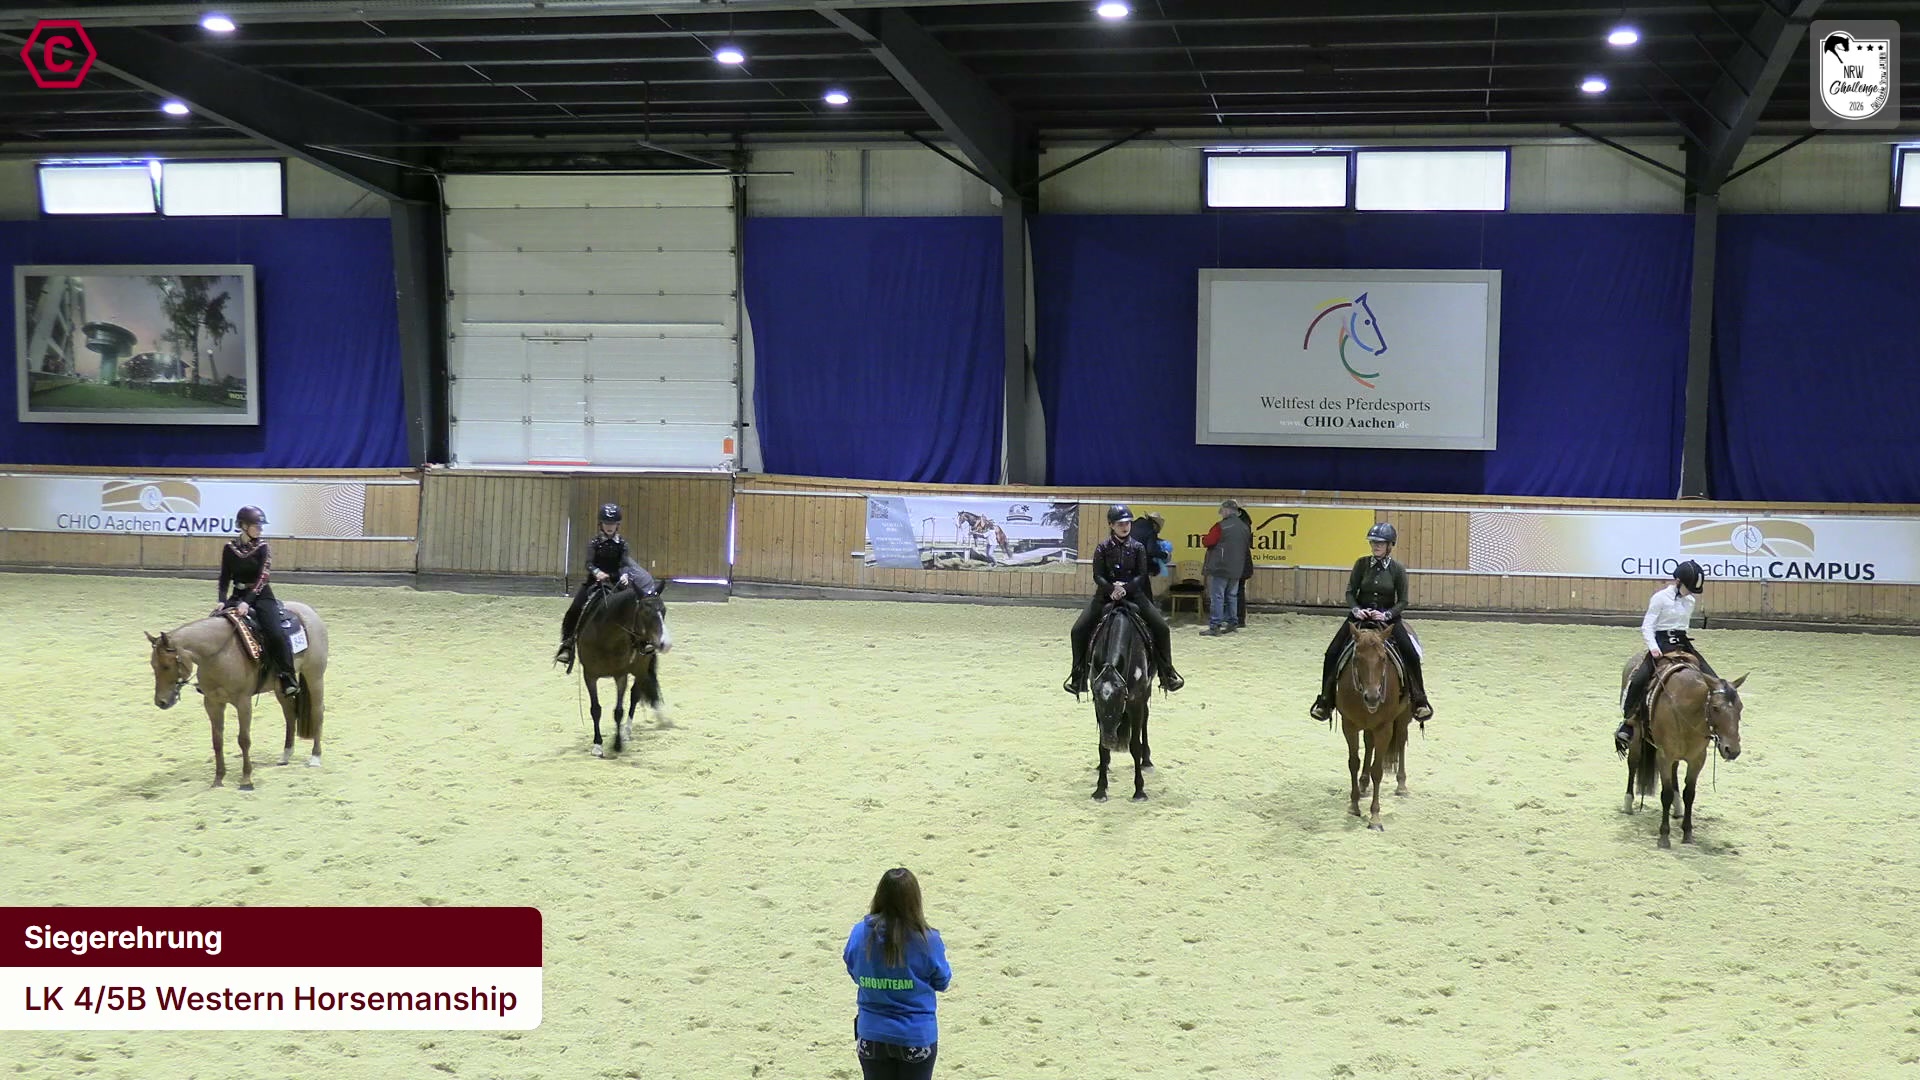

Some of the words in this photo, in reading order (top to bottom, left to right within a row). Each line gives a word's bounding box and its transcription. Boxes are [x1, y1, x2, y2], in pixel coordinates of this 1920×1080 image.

[1261, 395, 1315, 410] Weltfest
[1319, 397, 1342, 410] des
[1346, 397, 1431, 414] Pferdesports
[57, 513, 100, 530] CHIO
[104, 514, 161, 531] Aachen
[1621, 557, 1680, 575] CHIO
[1692, 560, 1763, 578] achen
[1768, 561, 1875, 581] CAMPUS
[859, 976, 914, 990] SHOWTEAM
